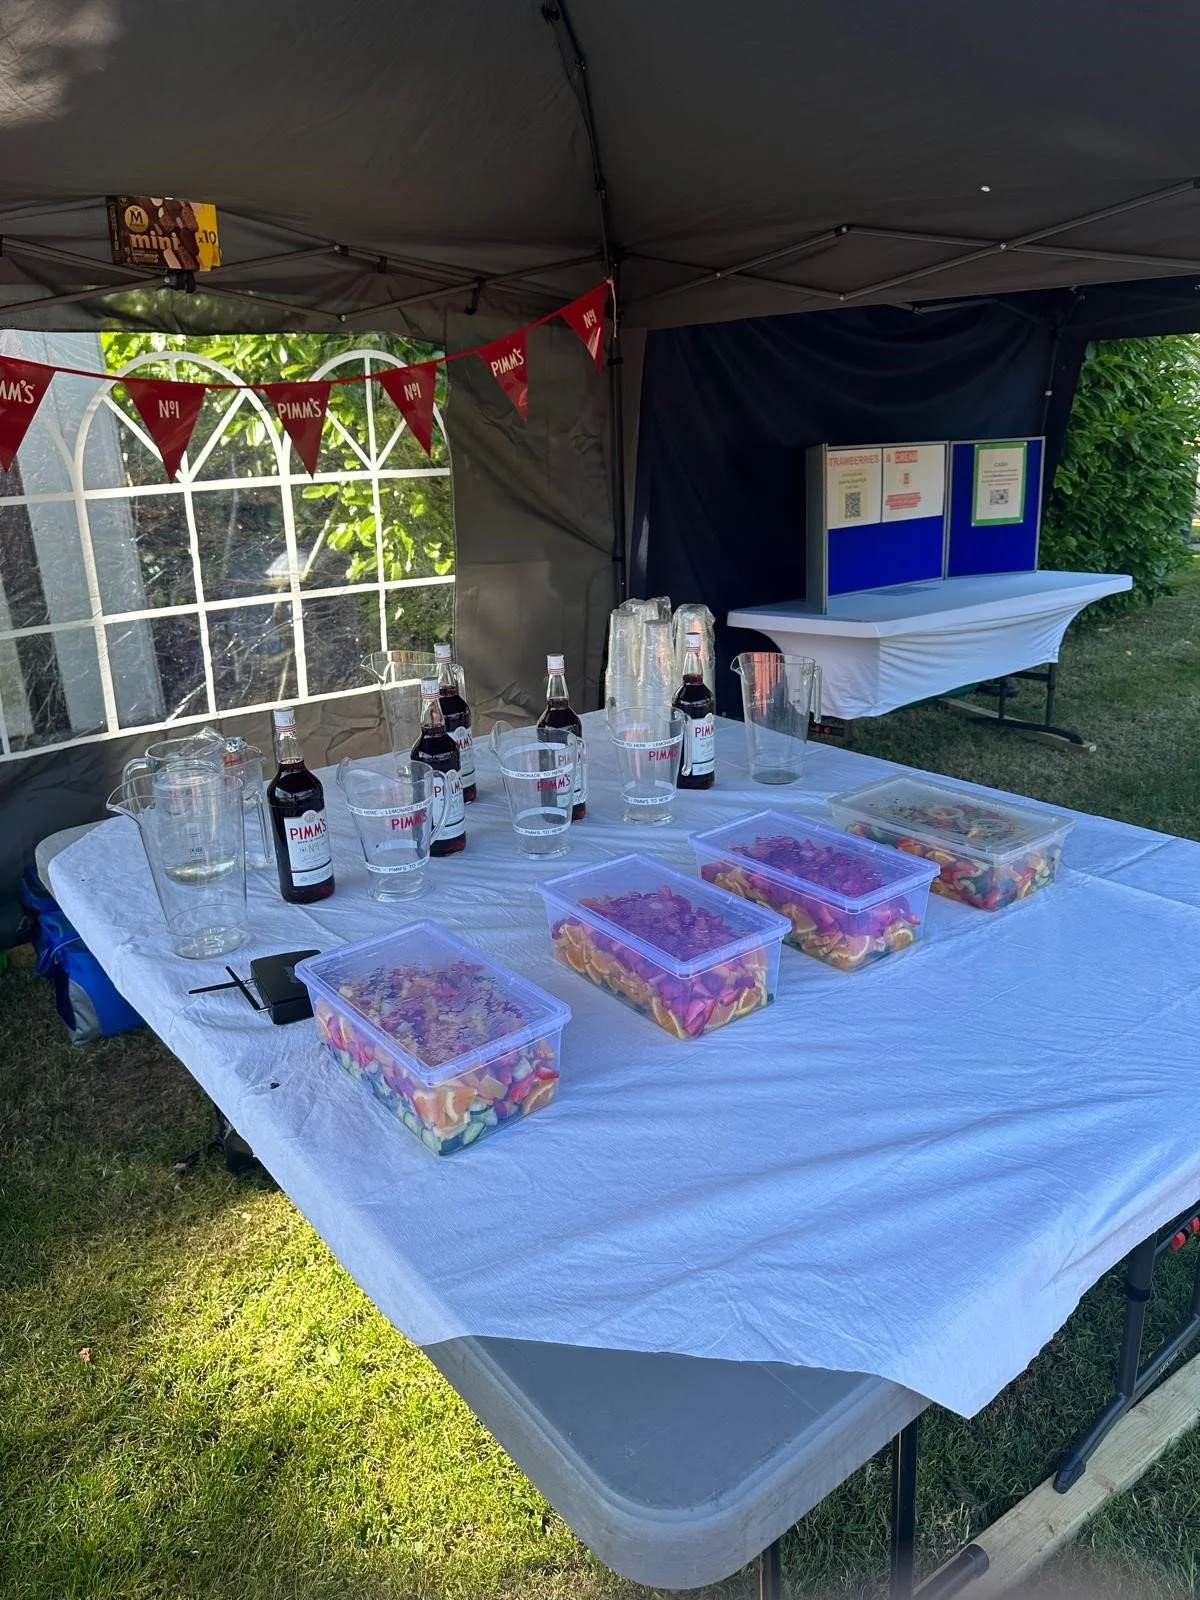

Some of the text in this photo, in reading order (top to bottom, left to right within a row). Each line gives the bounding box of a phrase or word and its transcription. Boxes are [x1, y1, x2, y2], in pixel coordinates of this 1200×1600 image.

[129, 209, 143, 224] M
[129, 230, 181, 250] mini
[198, 230, 217, 245] x10
[490, 347, 525, 377] PIMM'S
[0, 379, 35, 404] MM'S
[277, 397, 322, 420] PIMM'S
[536, 774, 571, 792] PIMM'S
[290, 817, 327, 841] PIMM'S
